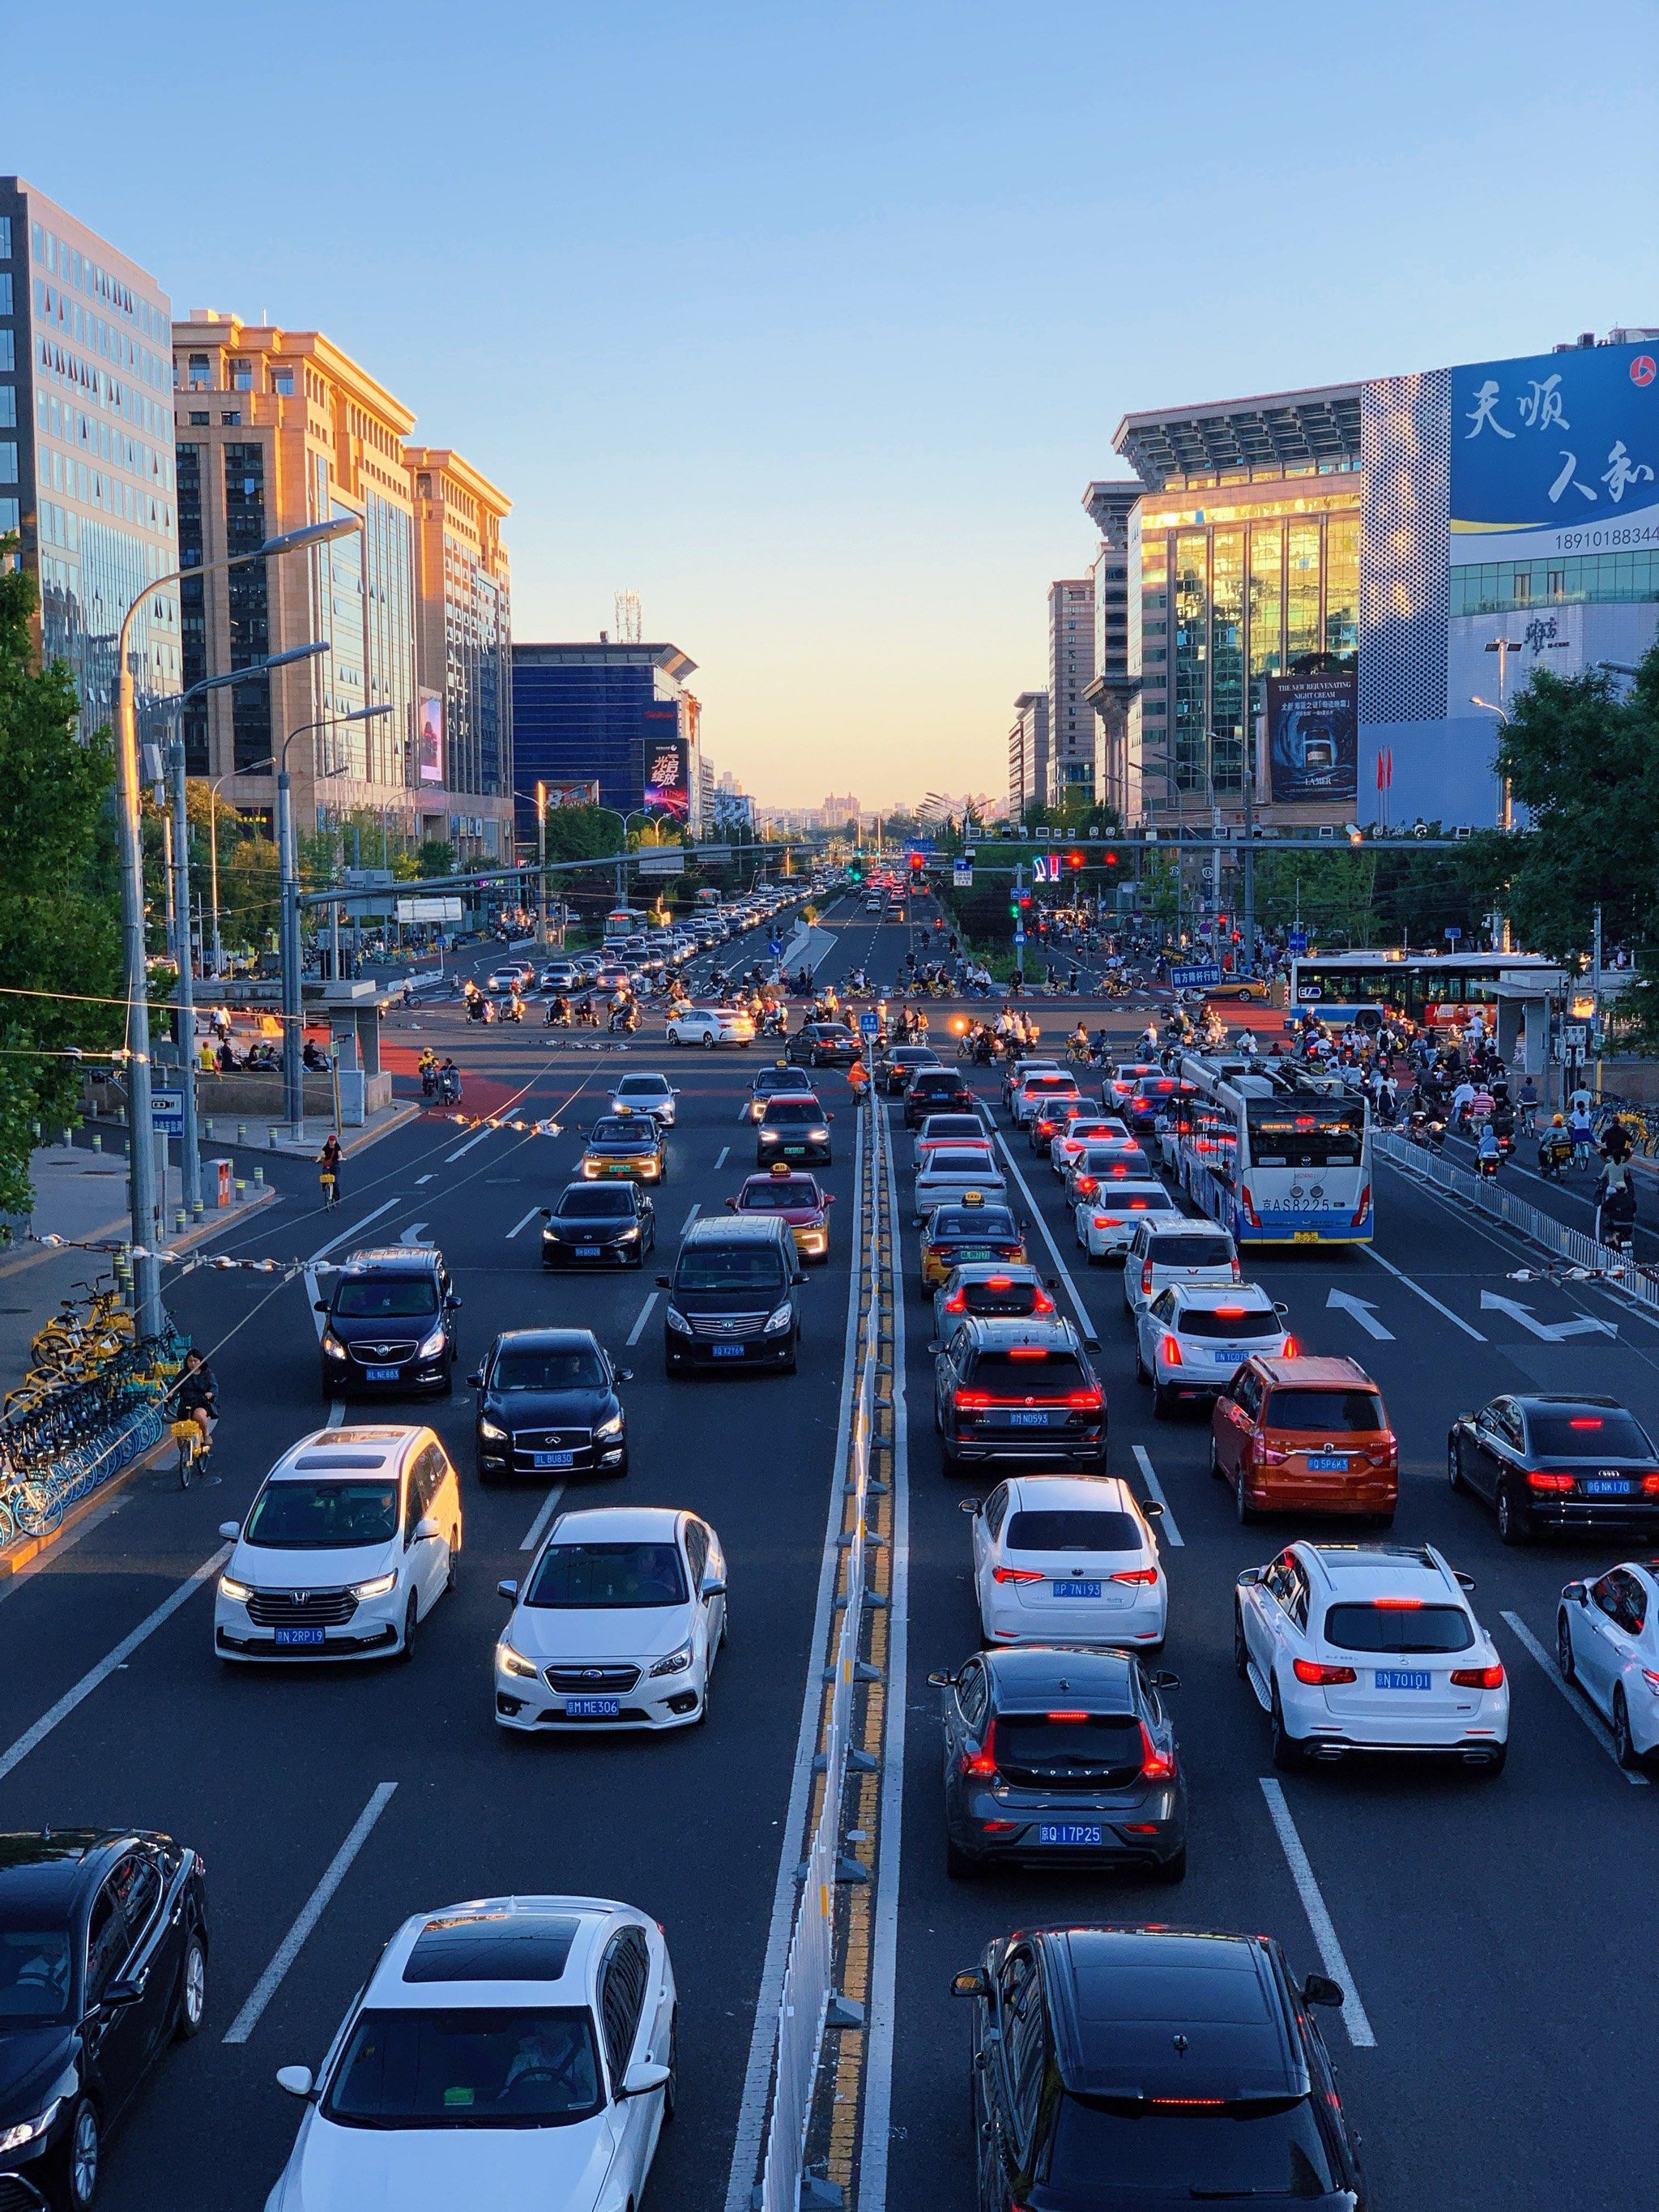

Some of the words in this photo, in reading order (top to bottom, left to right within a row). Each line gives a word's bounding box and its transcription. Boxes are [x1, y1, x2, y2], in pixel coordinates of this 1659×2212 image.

[1548, 440, 1655, 503] 人和
[1555, 527, 1659, 550] 18910188344
[1278, 684, 1292, 692] THE
[1306, 681, 1351, 691] REJUVENATING
[1294, 691, 1313, 700] NIGHT
[1314, 690, 1336, 698] CREAM
[1263, 1199, 1329, 1213] 京AS8225
